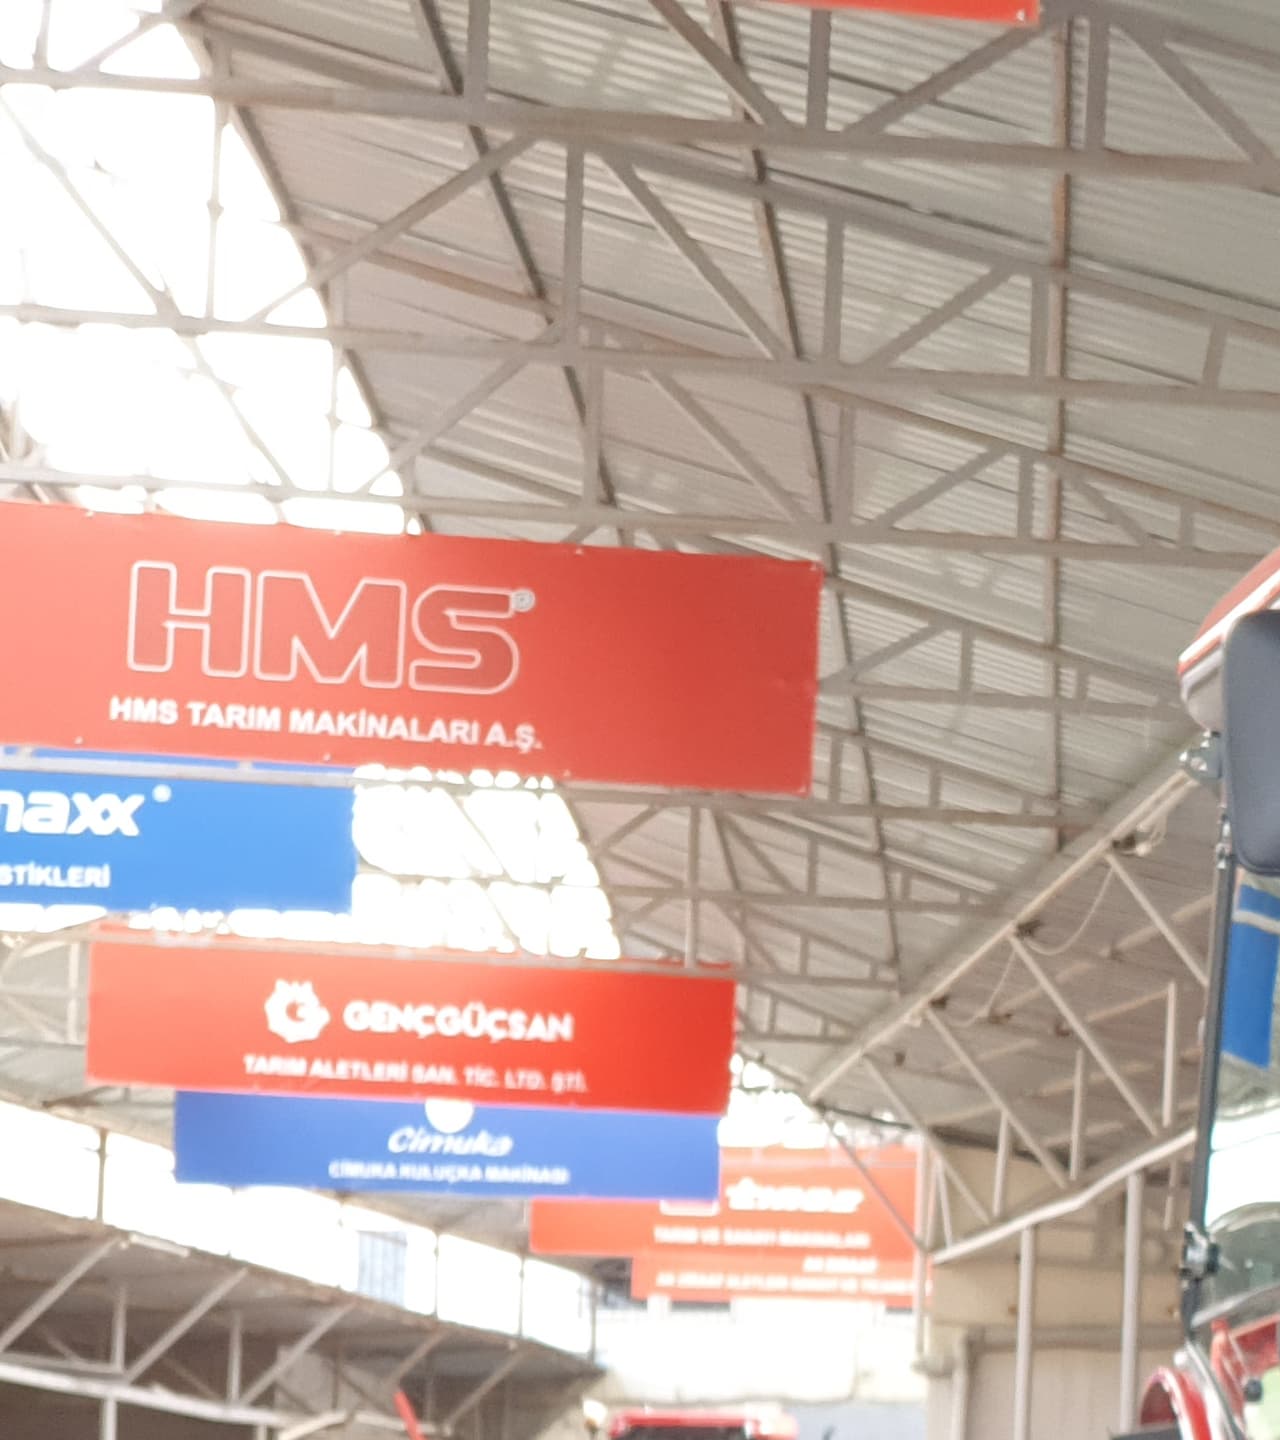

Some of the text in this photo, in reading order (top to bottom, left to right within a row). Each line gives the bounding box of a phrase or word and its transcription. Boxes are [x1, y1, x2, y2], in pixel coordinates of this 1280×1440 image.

[109, 697, 178, 725] HMS
[188, 702, 280, 731] TARIM
[289, 708, 478, 746] MAKİNALARI
[342, 1000, 575, 1043] GENÇGÜÇSAN
[244, 1053, 307, 1076] TARIM
[387, 1124, 514, 1157] Cimuka
